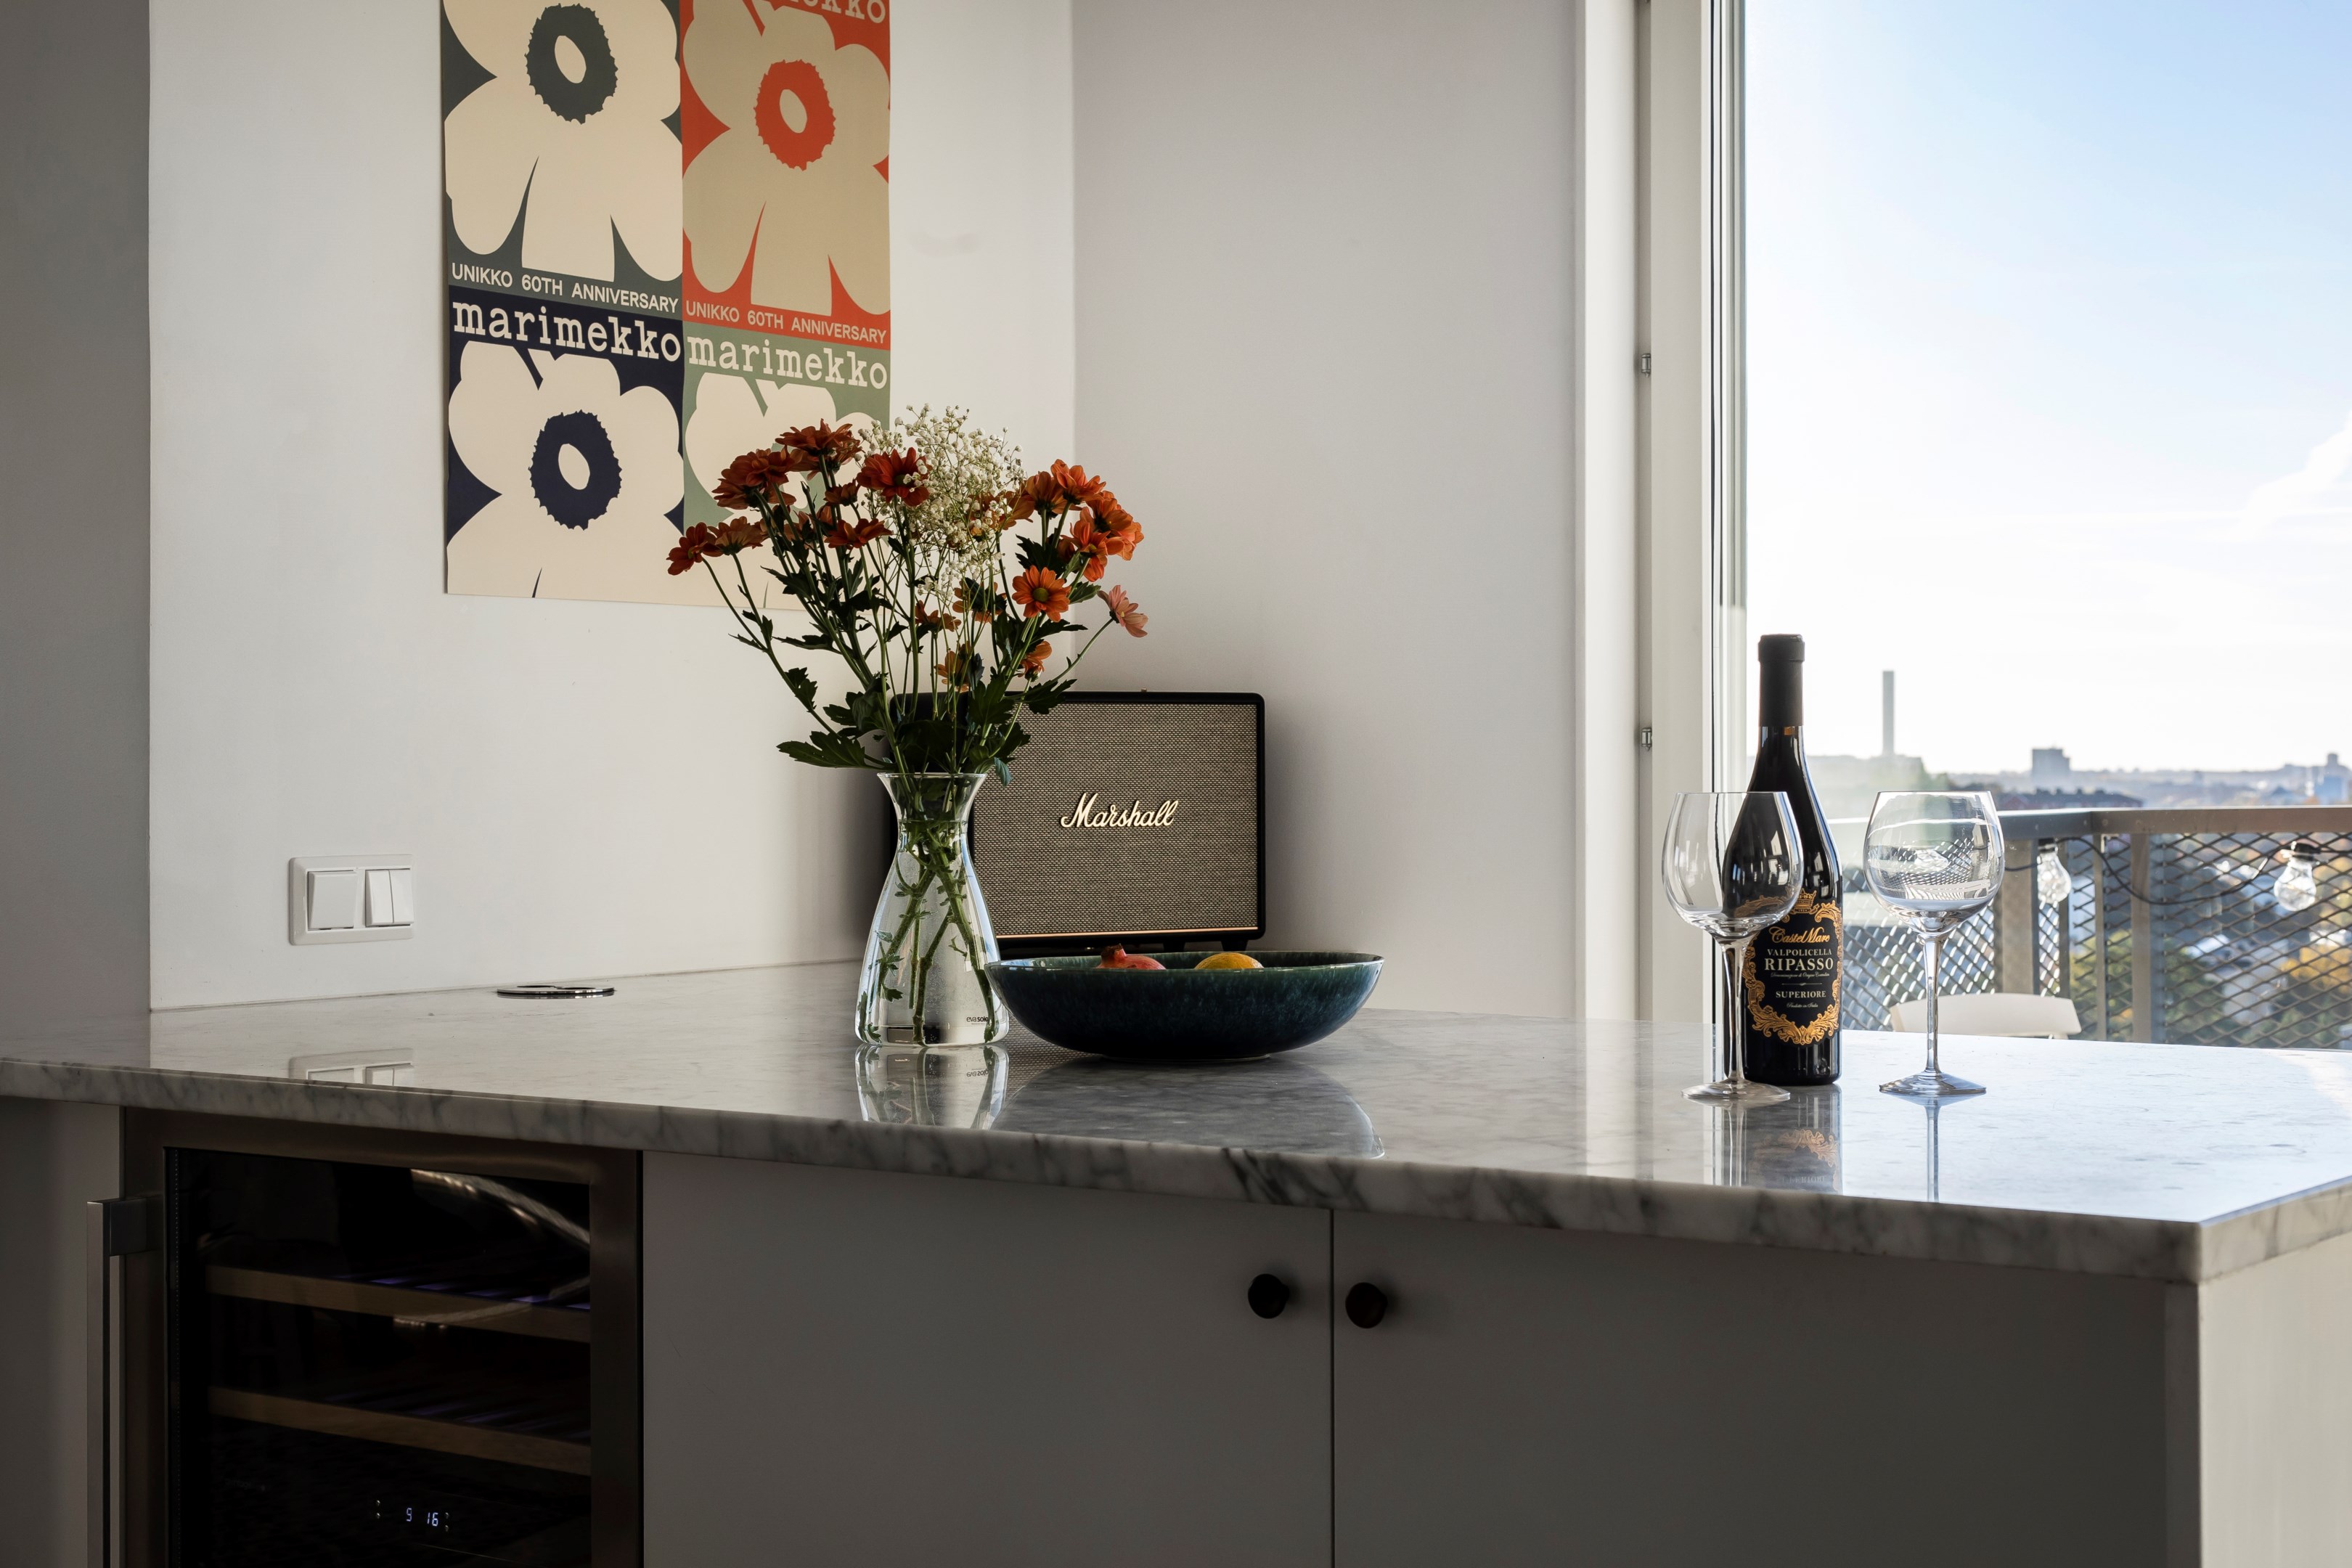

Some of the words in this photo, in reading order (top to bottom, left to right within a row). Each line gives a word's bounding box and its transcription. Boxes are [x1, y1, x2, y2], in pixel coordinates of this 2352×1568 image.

[452, 262, 513, 288] UNIKKO
[521, 274, 563, 296] 60TH
[571, 282, 679, 314] ANNIVERSARY
[452, 301, 681, 362] marimekko
[685, 300, 740, 322] UNIKKO
[747, 310, 783, 330] 60TH
[791, 317, 887, 344] ANNIVERSARY
[687, 336, 888, 390] marimekko
[1061, 792, 1179, 828] Marshall
[1765, 957, 1834, 971] RIPASSO
[406, 1508, 412, 1522] 9
[427, 1512, 438, 1527] 16
